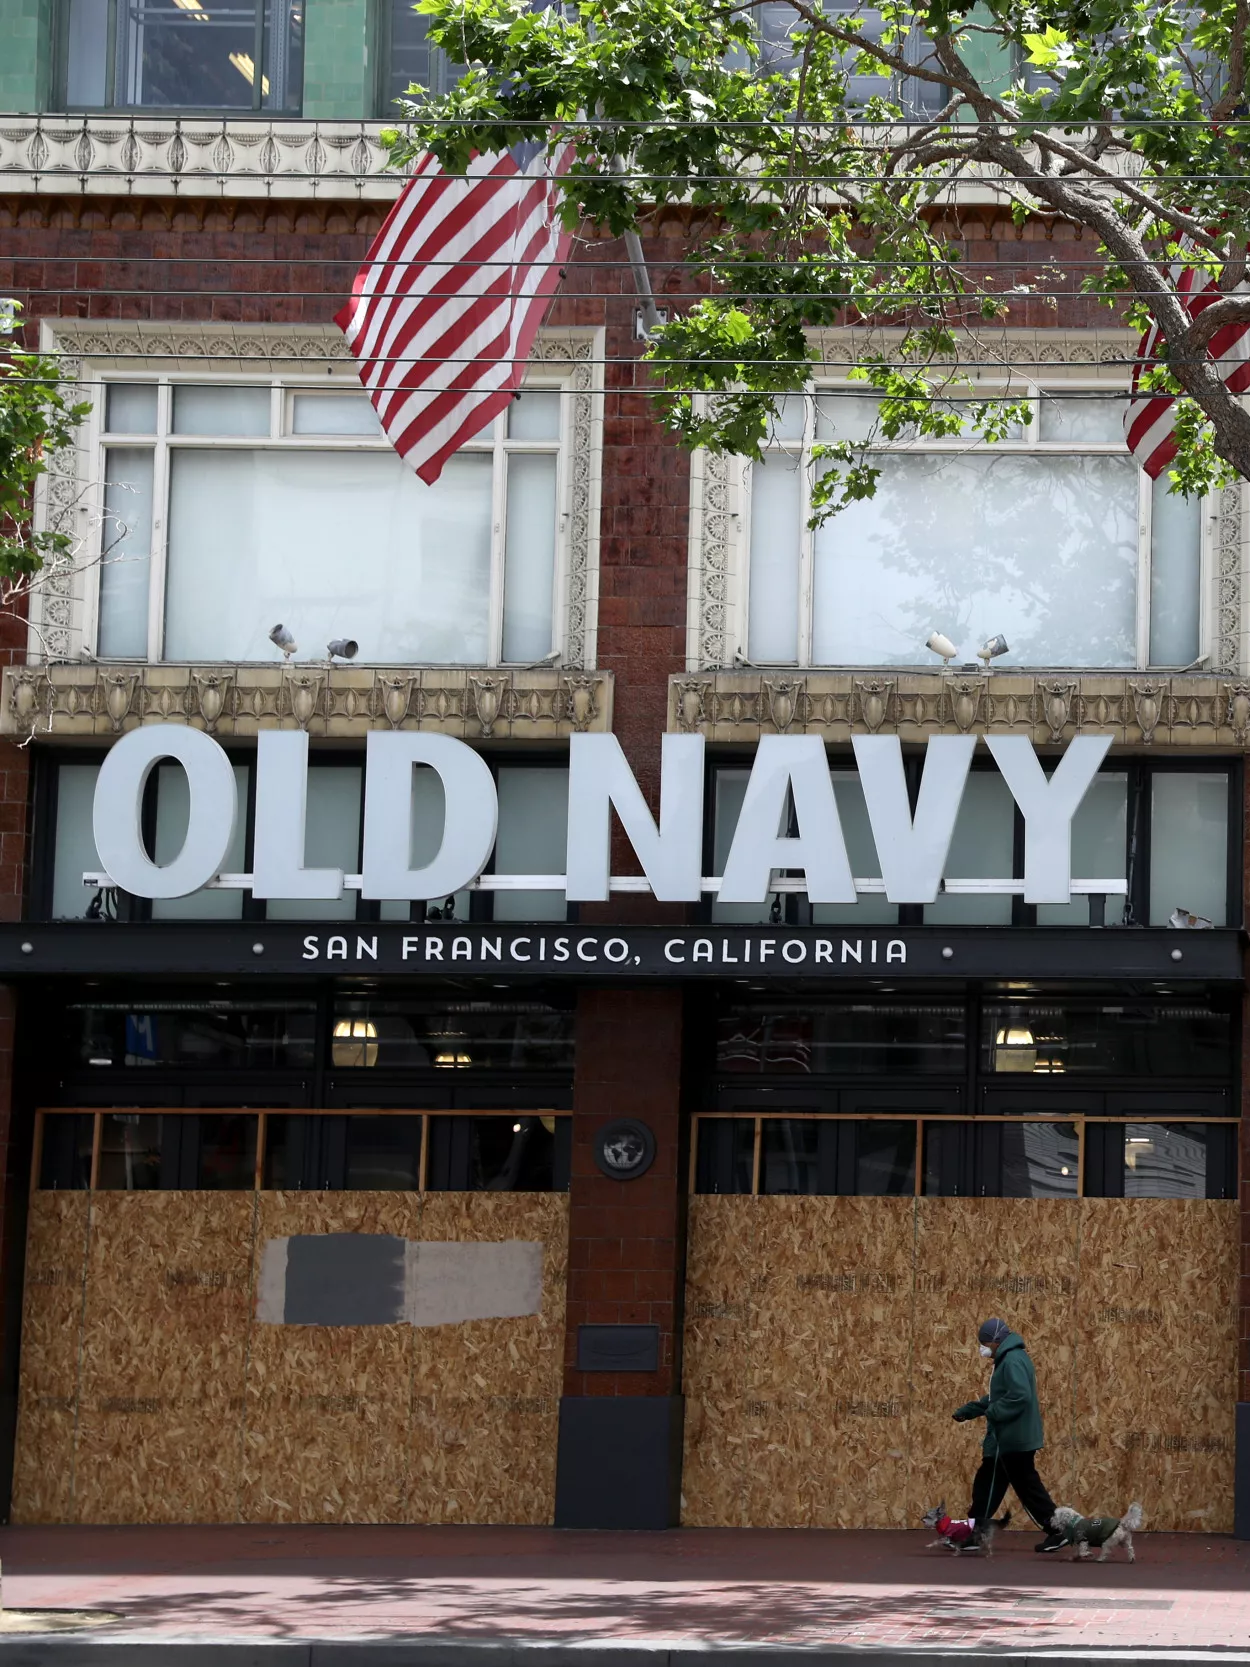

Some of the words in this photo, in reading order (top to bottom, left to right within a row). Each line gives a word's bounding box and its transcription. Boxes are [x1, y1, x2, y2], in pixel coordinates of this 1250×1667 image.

[93, 723, 498, 900] OLD
[565, 732, 1116, 904] NAVY
[302, 936, 378, 960] SAN
[402, 937, 641, 966] FRANCISCO,
[664, 938, 907, 963] CALIFORNIA
